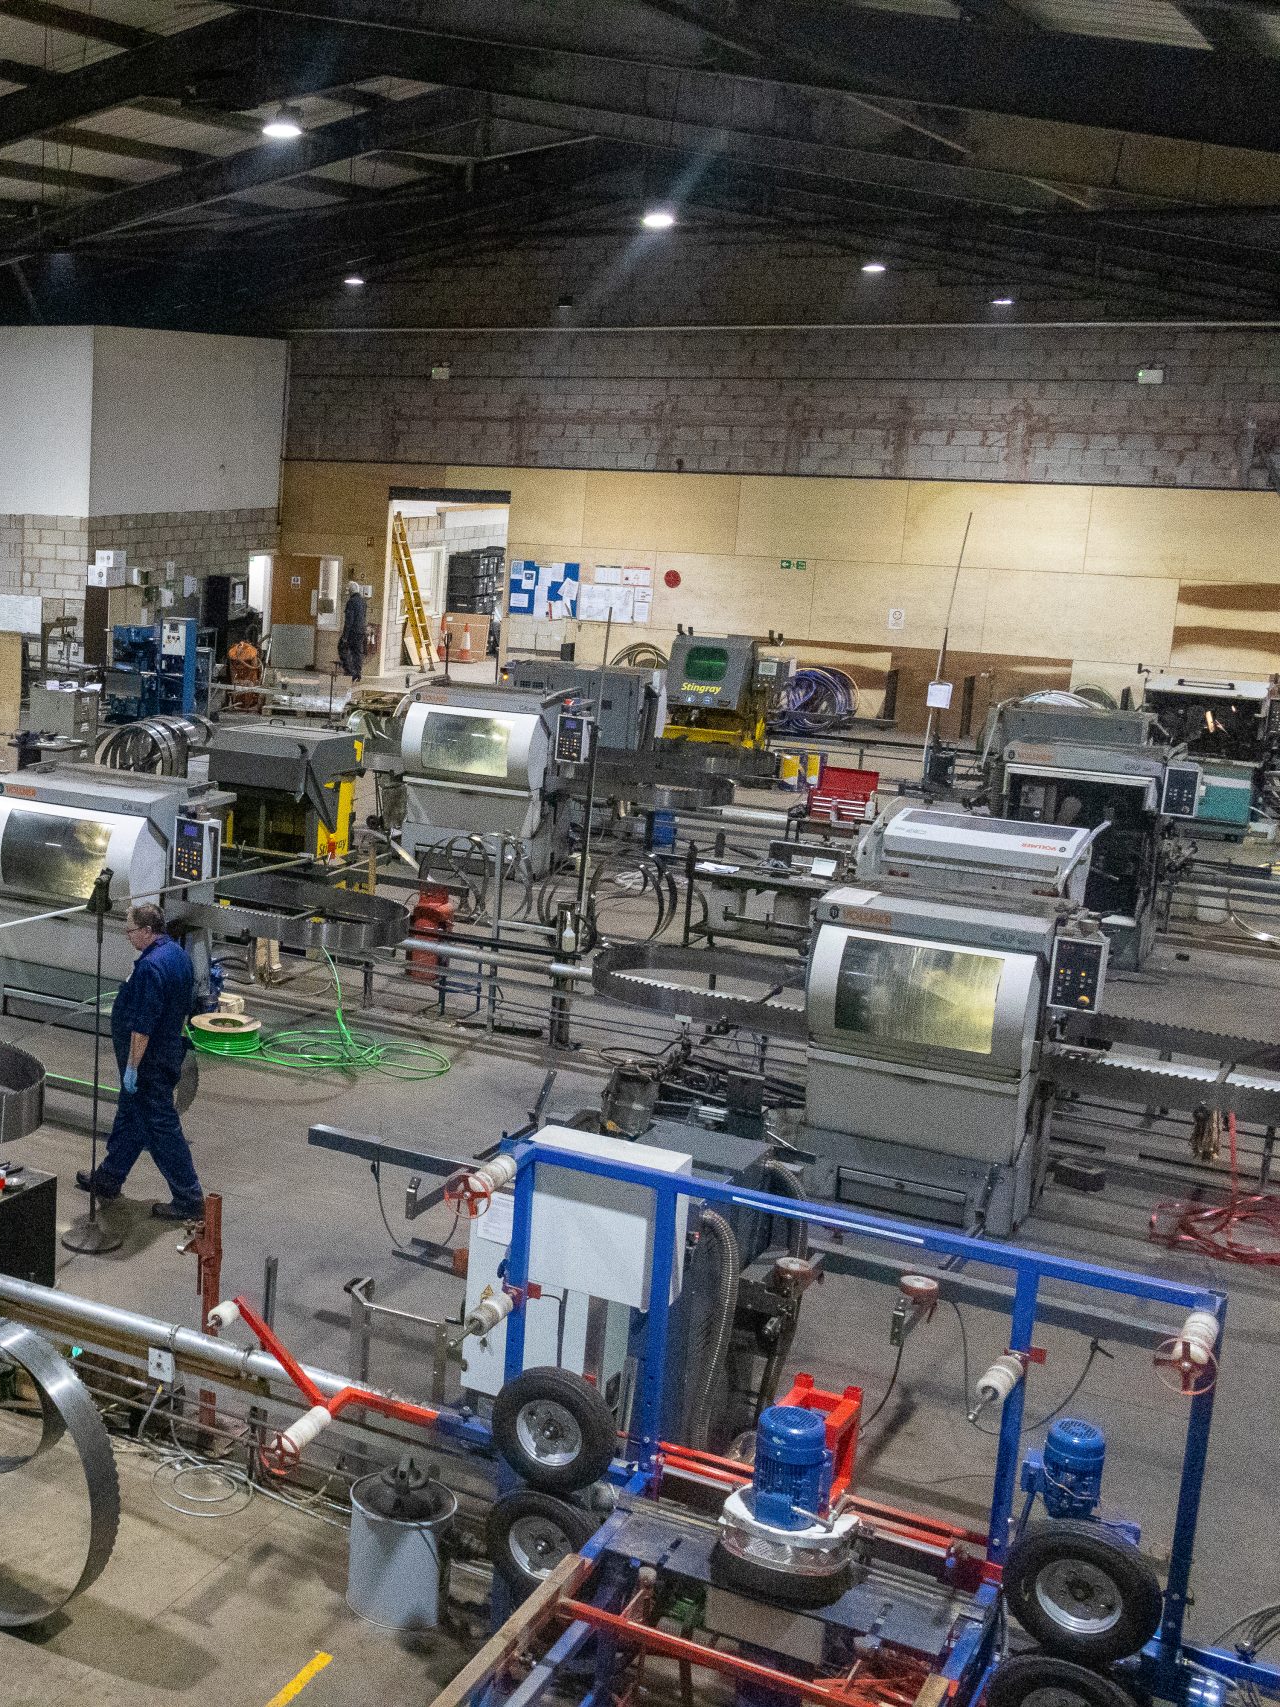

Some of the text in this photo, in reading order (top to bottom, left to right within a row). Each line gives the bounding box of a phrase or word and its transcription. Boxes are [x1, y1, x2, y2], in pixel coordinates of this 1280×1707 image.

[681, 682, 722, 695] Stingray
[319, 839, 346, 855] Stiray
[1021, 842, 1056, 851] VOLLMER
